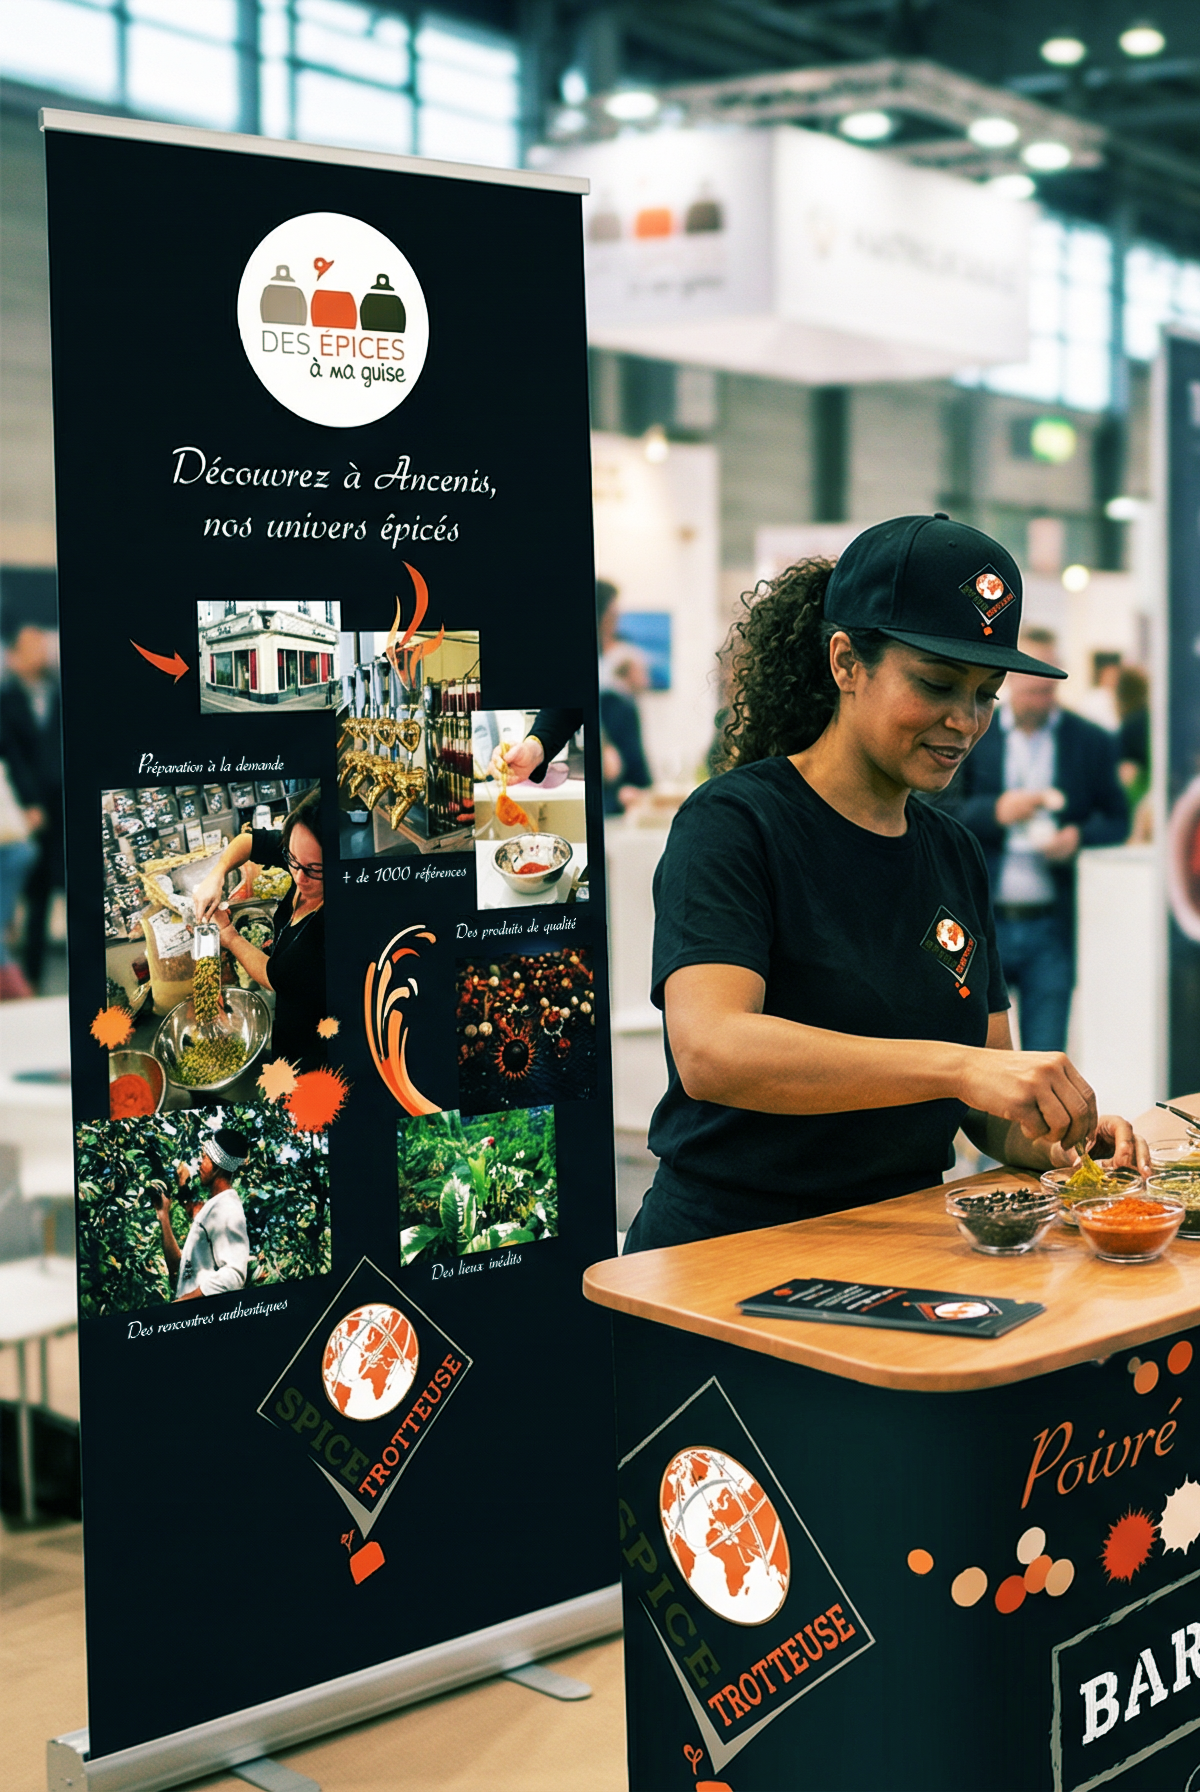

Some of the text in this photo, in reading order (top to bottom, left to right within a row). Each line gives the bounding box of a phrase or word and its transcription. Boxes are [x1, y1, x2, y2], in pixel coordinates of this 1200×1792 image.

[262, 329, 405, 361] DES ÉPICES
[309, 356, 407, 388] à ma guise
[172, 446, 497, 500] Découvrez à Ancenis,
[203, 516, 252, 538] nos
[266, 511, 367, 540] univers
[138, 752, 285, 777] Préparation à la demande
[342, 863, 467, 884] + de 1000 références
[456, 915, 577, 941] Des produits de qualité
[431, 1250, 522, 1281] Des lieux inédits
[127, 1299, 289, 1340] Des rencontres authentiques
[275, 1387, 370, 1486] SPICE
[358, 1353, 463, 1498] TROTTEUSE
[1020, 1396, 1183, 1510] Poivré
[707, 1602, 857, 1727] TROTTEUSE
